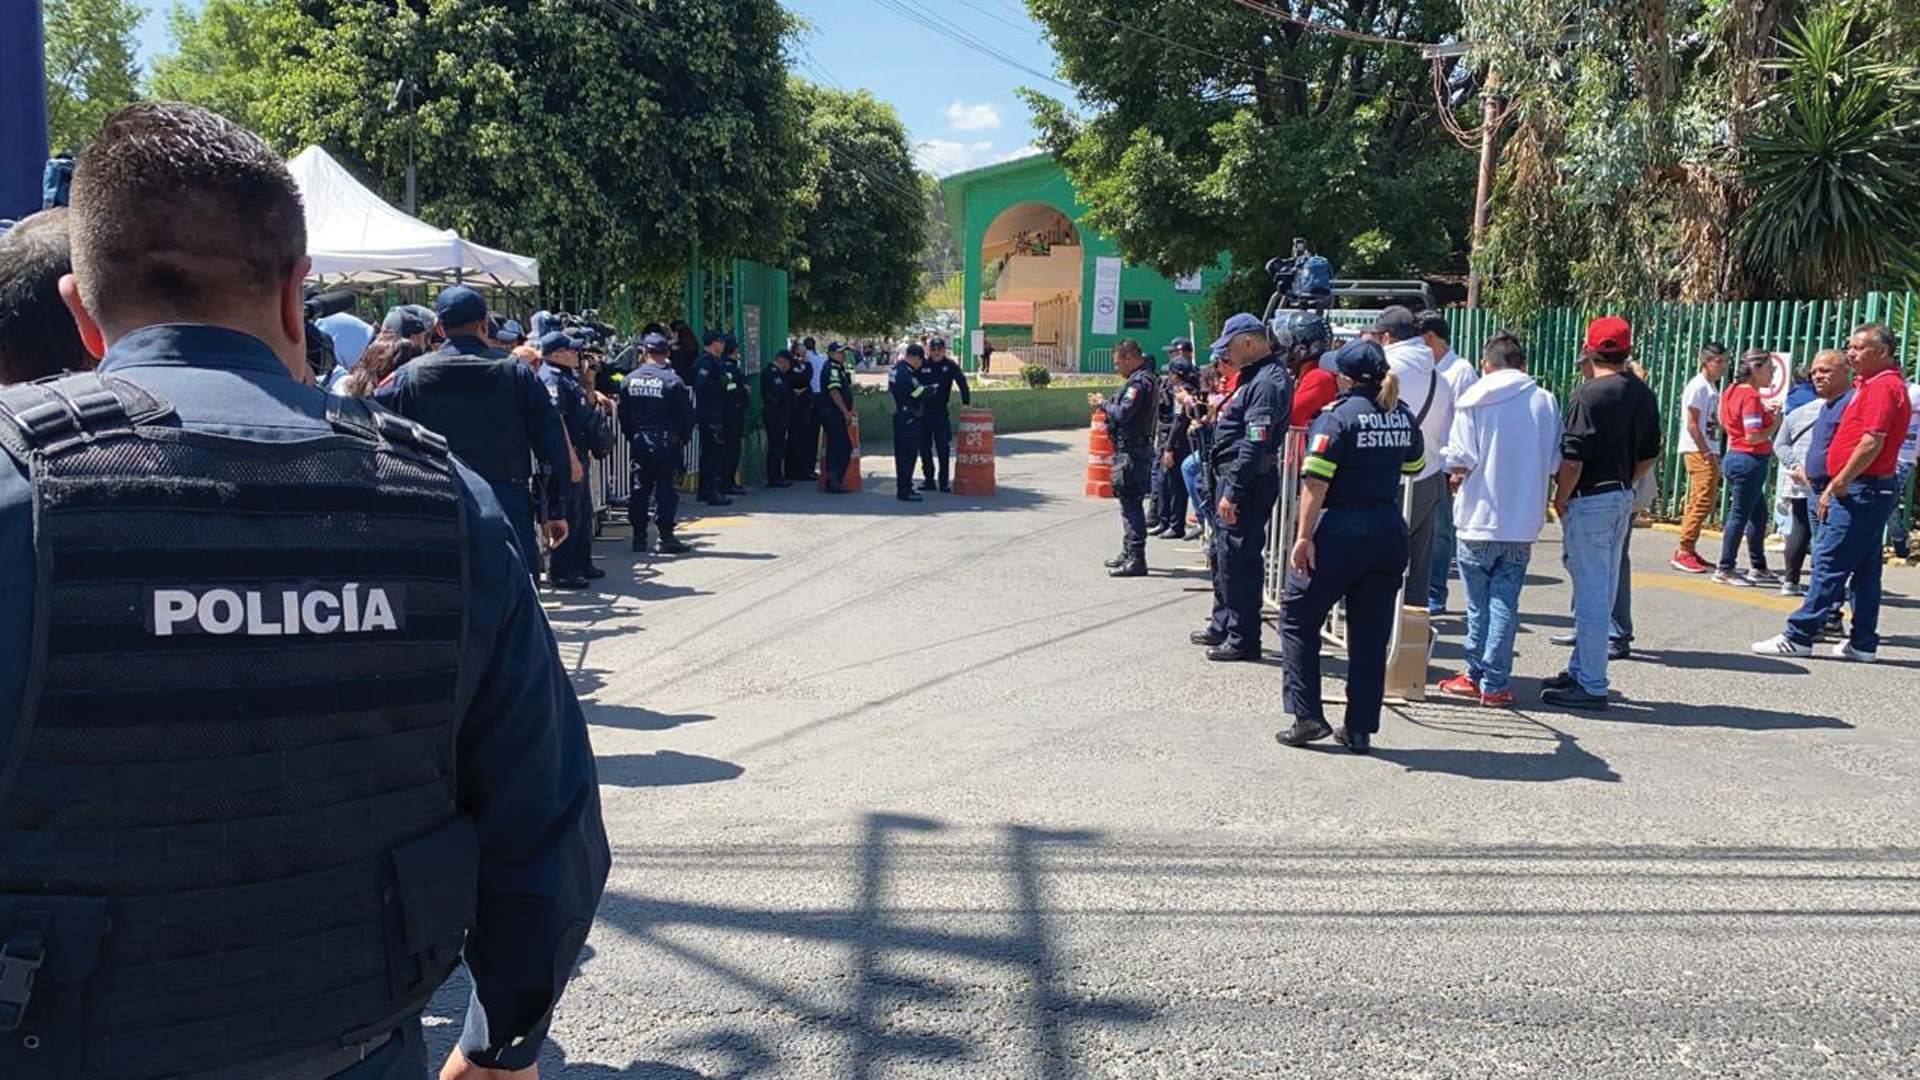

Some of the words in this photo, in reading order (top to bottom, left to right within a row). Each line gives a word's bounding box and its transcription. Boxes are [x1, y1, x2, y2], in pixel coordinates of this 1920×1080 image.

[1357, 410, 1411, 429] POLICÍA
[1357, 430, 1411, 447] ESTATAL
[153, 582, 398, 636] POLICÍA
